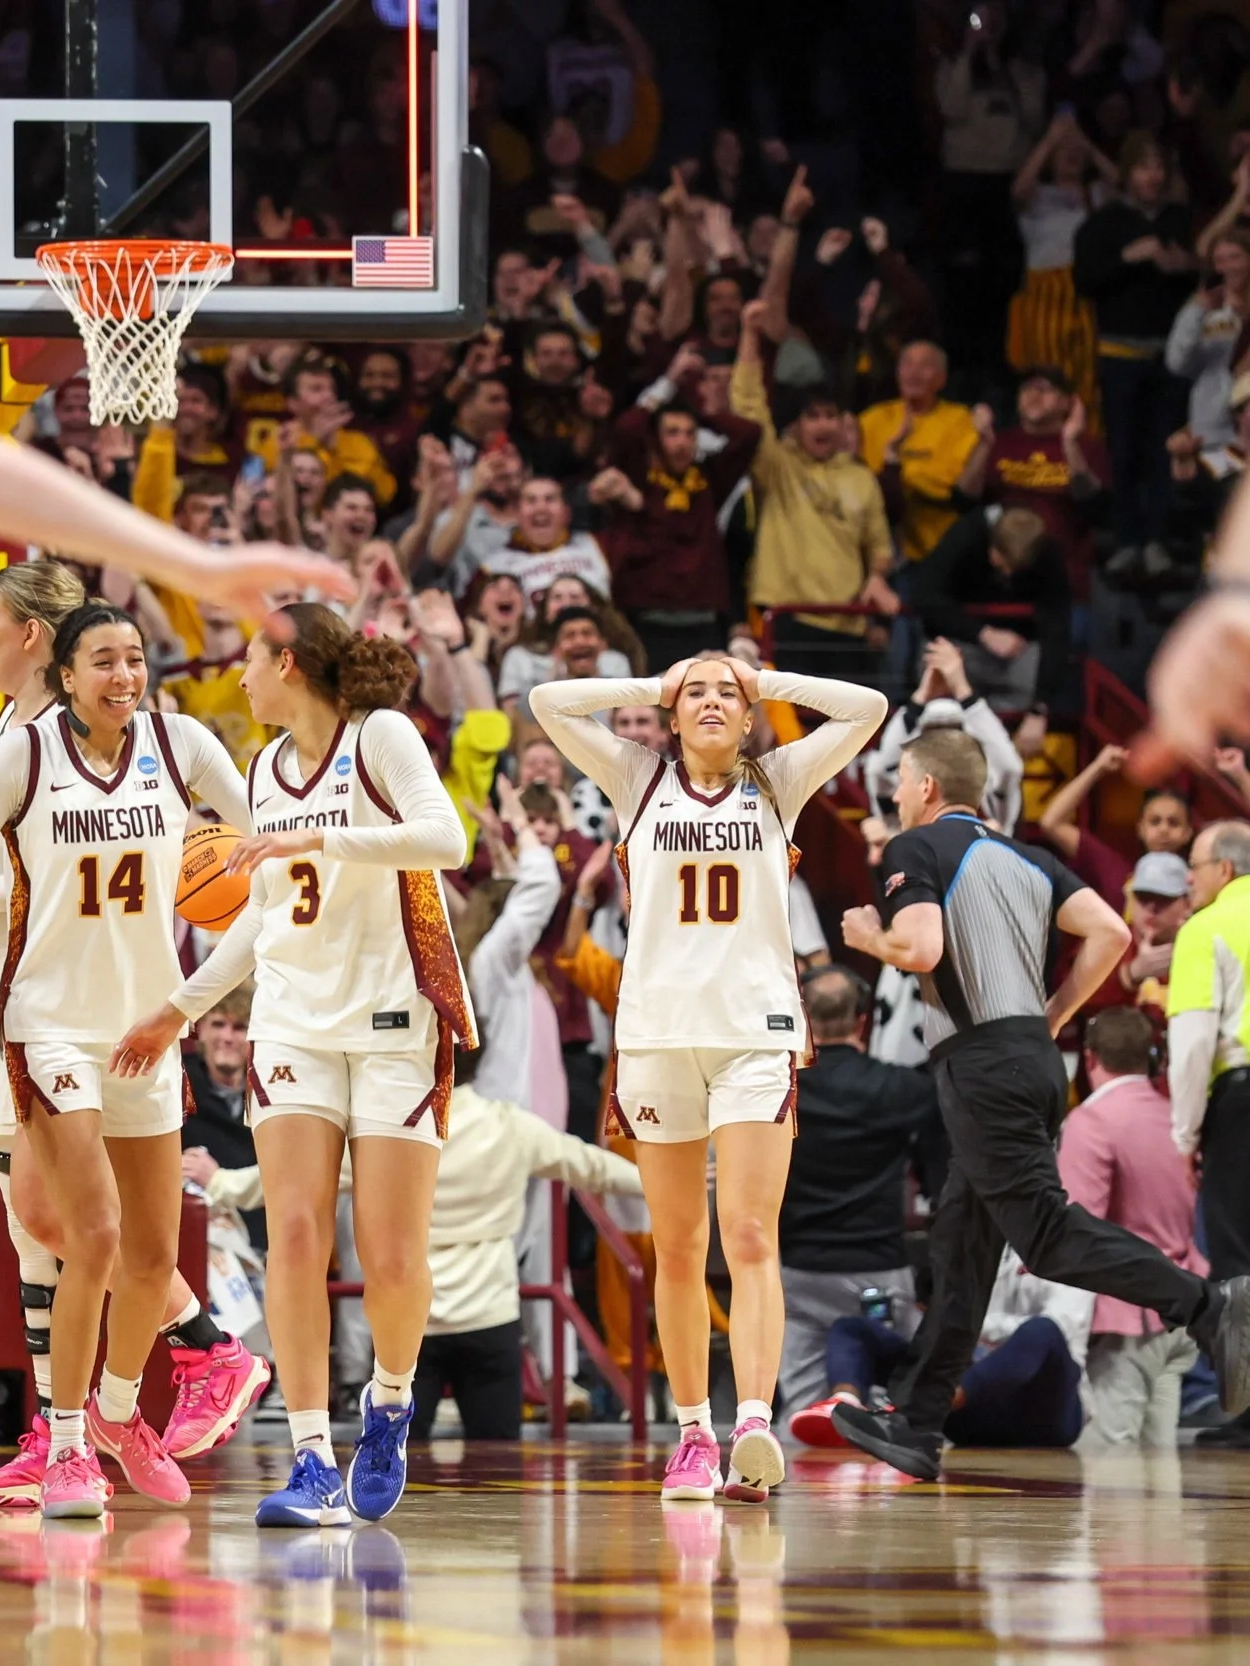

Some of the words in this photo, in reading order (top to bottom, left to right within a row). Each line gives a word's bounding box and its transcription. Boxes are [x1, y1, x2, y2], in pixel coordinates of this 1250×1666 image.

[52, 804, 166, 844] MINNESOTA
[653, 822, 763, 851] MINNESOTA
[77, 850, 146, 918] 14
[289, 860, 321, 928] 3
[678, 862, 741, 925] 10
